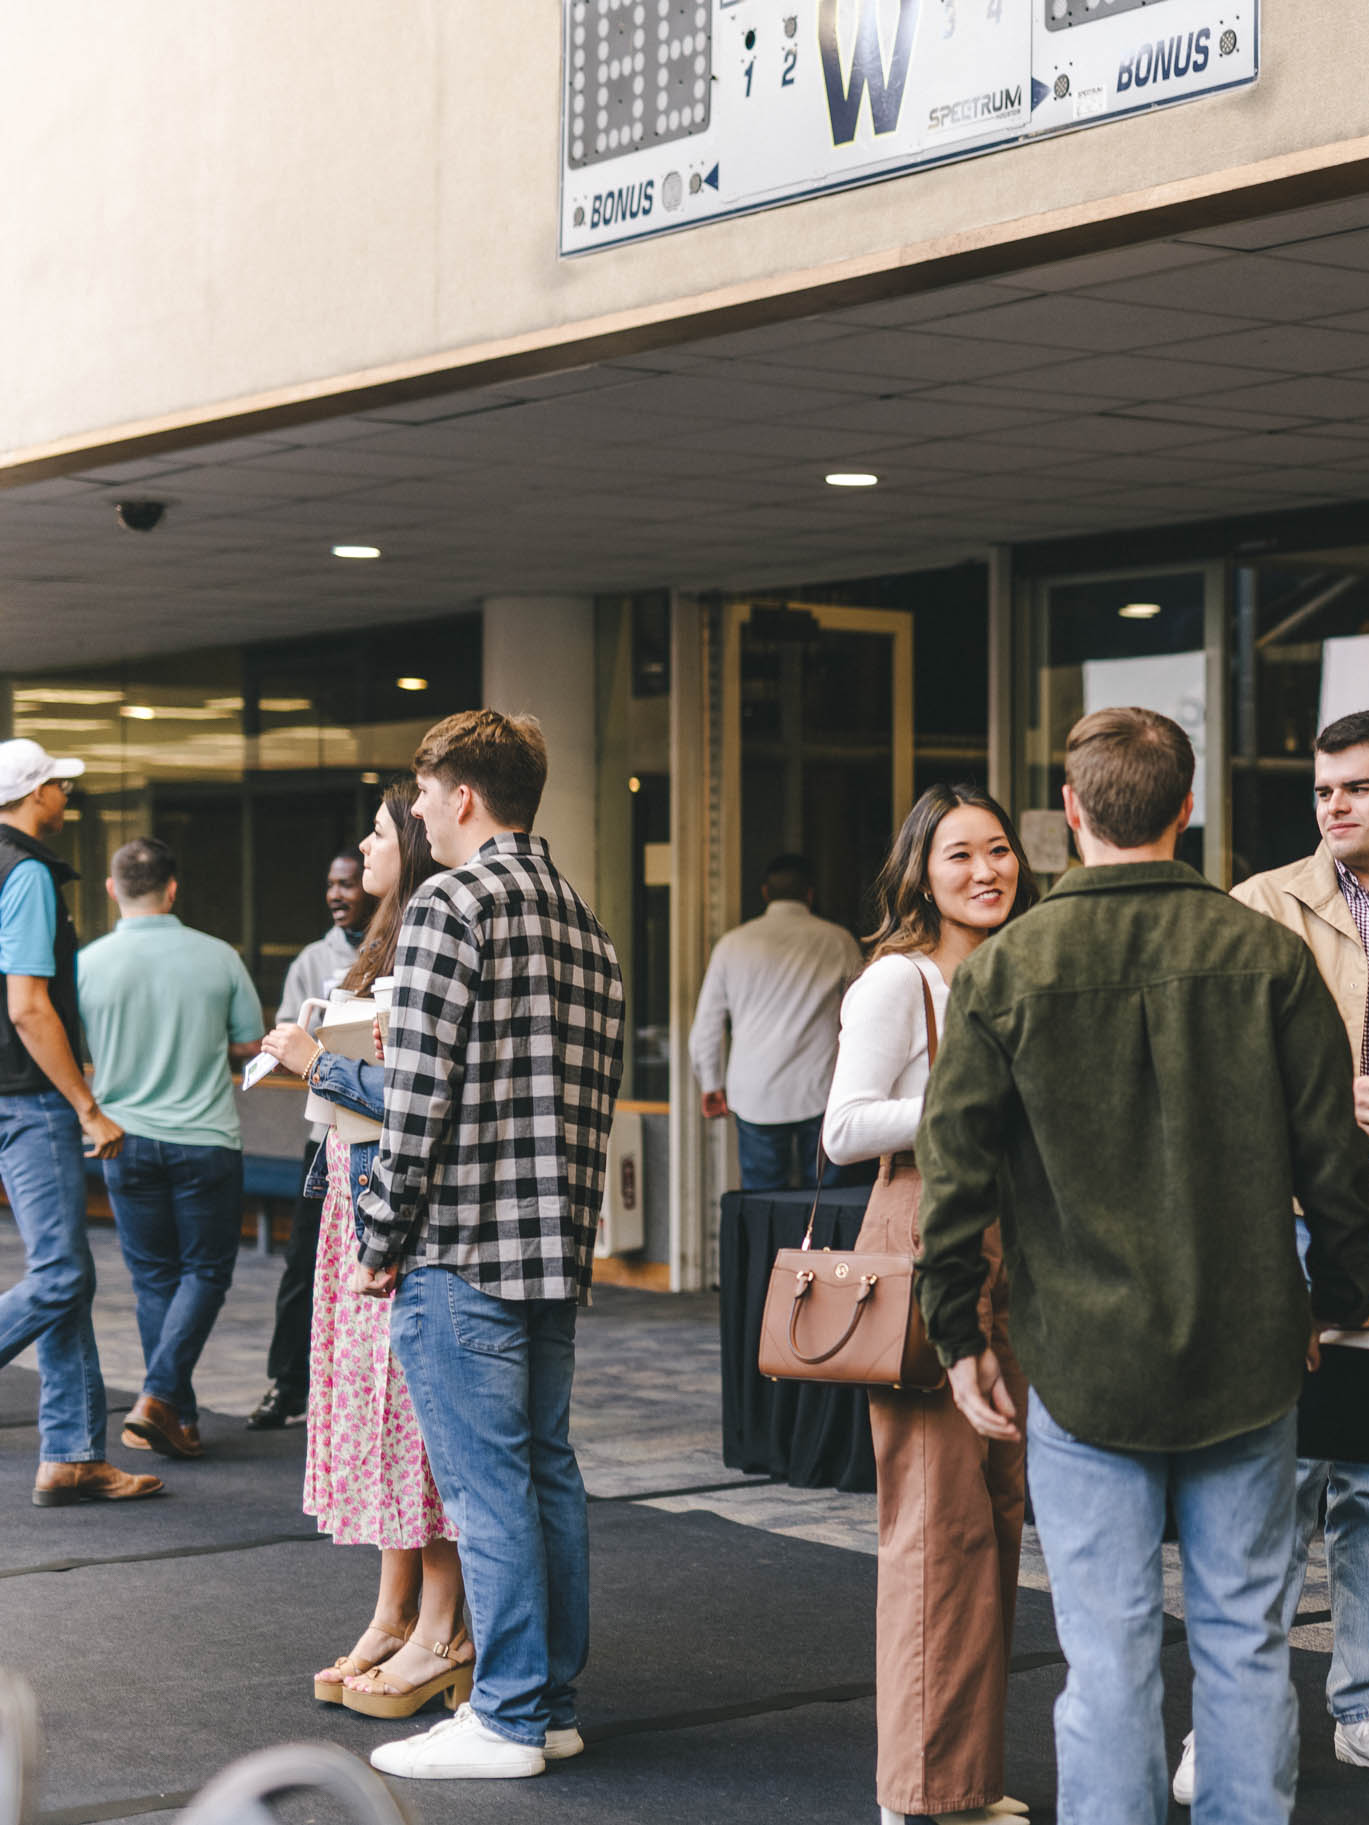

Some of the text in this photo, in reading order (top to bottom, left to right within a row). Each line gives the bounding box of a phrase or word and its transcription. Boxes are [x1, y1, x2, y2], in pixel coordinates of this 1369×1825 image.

[743, 48, 798, 98] 1 2
[816, 0, 922, 148] W
[1116, 27, 1211, 93] BONUS
[927, 84, 1022, 131] SPECTRUM
[590, 179, 655, 230] BONUS
